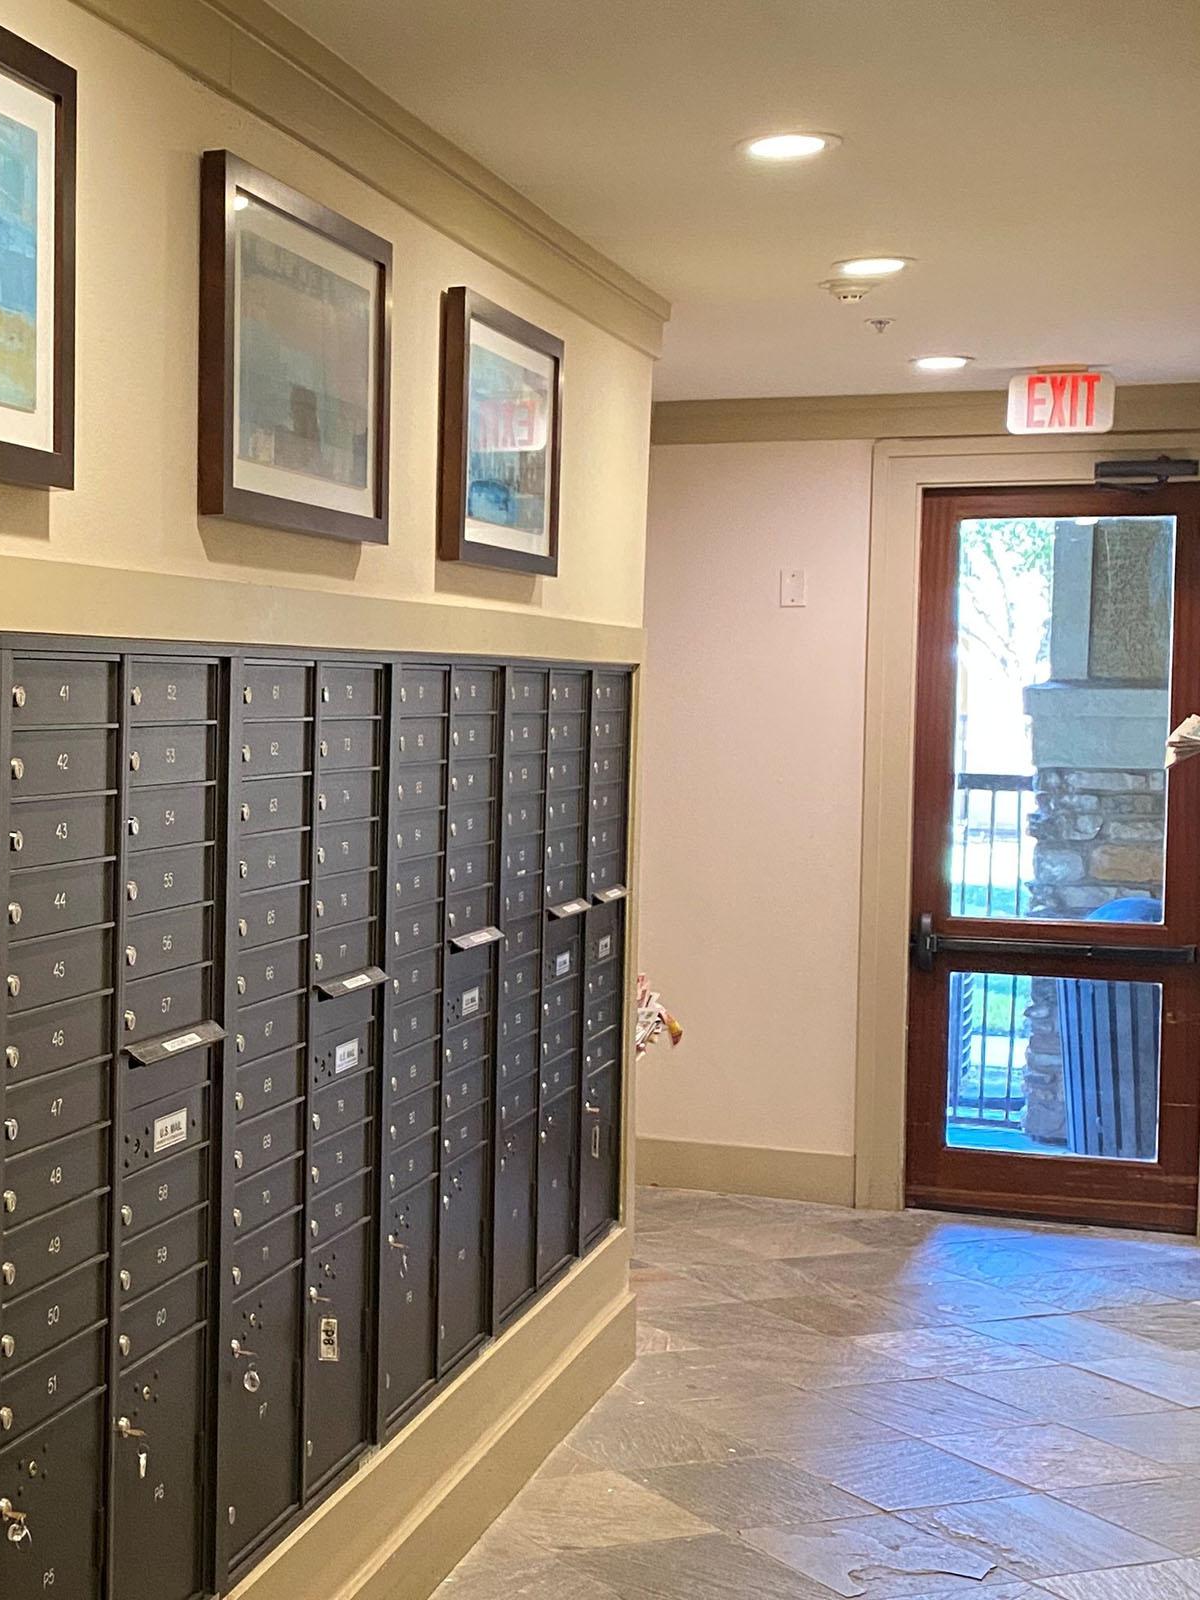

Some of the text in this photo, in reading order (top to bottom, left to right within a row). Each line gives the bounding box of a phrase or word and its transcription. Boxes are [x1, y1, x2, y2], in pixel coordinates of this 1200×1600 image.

[1026, 374, 1101, 428] EXIT
[58, 684, 70, 702] 41
[56, 753, 69, 770] 42
[165, 810, 175, 826] 54
[55, 822, 68, 839] 43
[163, 872, 174, 888] 55
[54, 892, 66, 909] 44
[162, 934, 172, 951] 56
[53, 960, 65, 978] 45
[161, 996, 172, 1014] 57
[51, 1029, 64, 1047] 46
[50, 1097, 63, 1117] 47
[49, 1166, 62, 1184] 48
[158, 1183, 169, 1202] 58
[48, 1236, 61, 1253] 49
[157, 1246, 168, 1264] 59
[47, 1305, 60, 1326] 50
[156, 1307, 167, 1327] 60
[322, 1329, 335, 1346] p8
[47, 1374, 58, 1395] 51
[43, 1567, 55, 1589] p5
